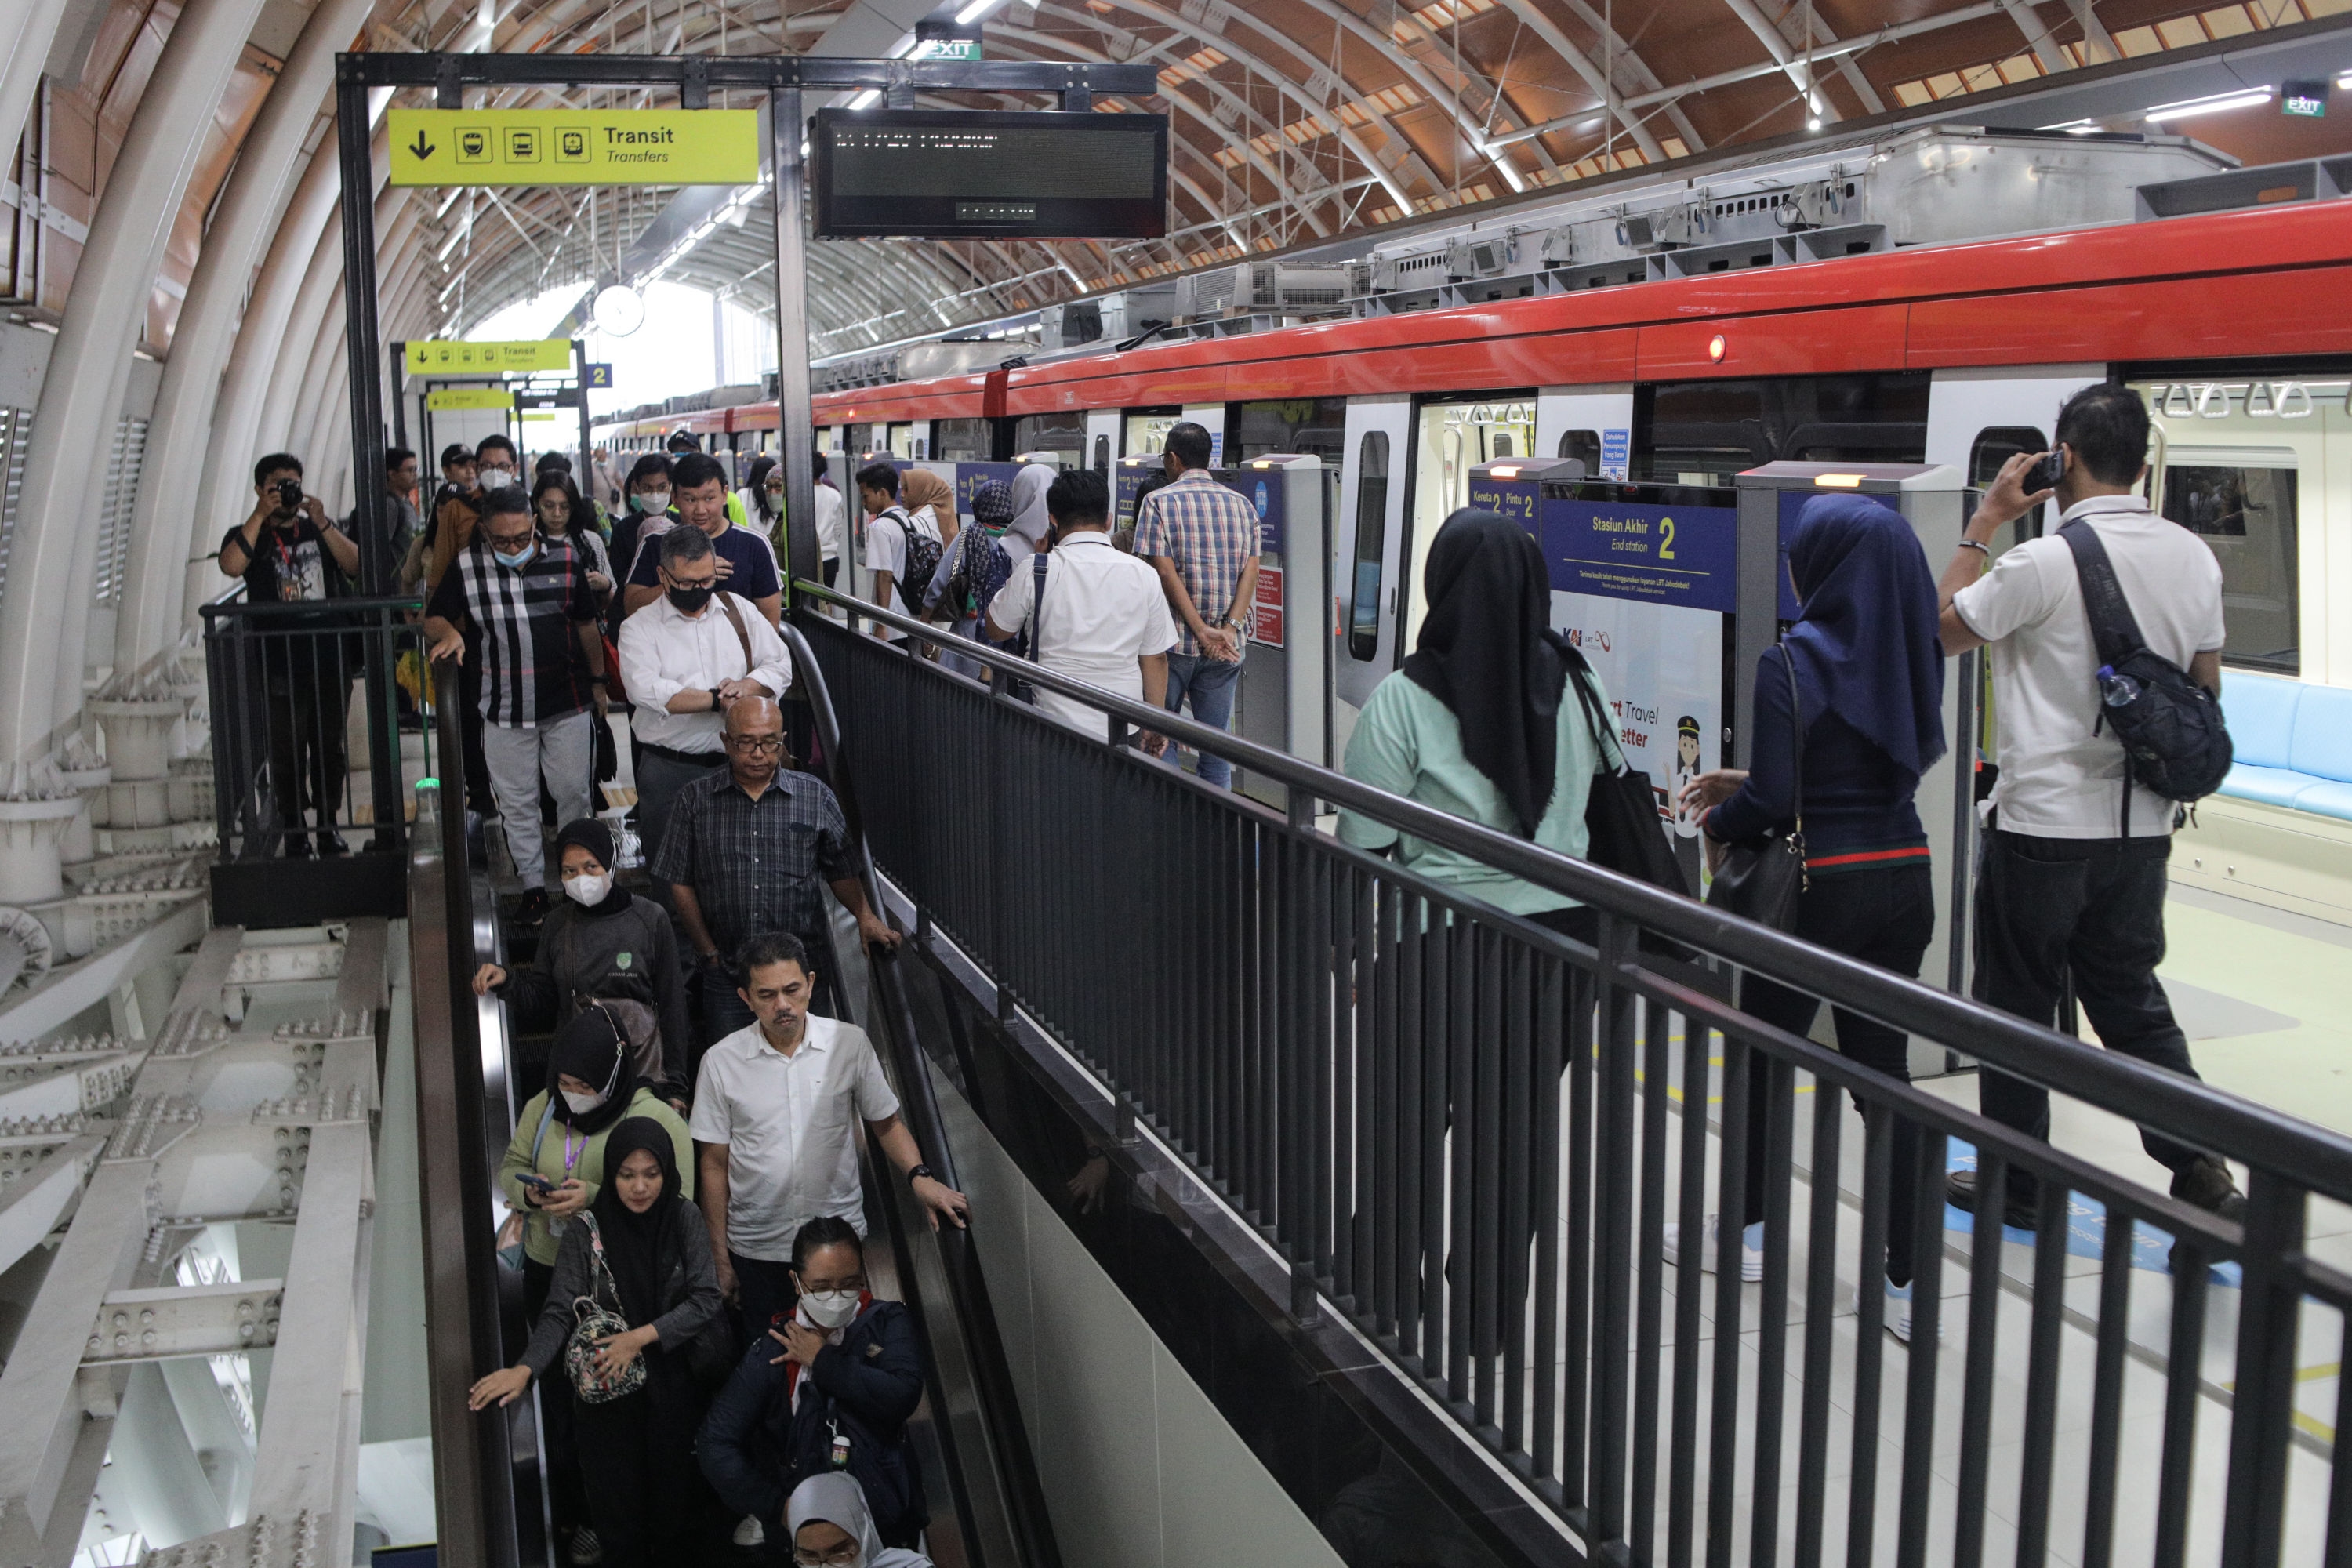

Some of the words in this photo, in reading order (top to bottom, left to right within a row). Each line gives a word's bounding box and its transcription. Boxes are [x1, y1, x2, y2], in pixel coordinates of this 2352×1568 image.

[927, 42, 973, 56] EXIT
[2288, 99, 2321, 111] EXIT
[603, 126, 675, 144] Transit
[606, 150, 669, 163] Transfers
[503, 346, 536, 355] Transit
[593, 367, 606, 384] 2
[1474, 490, 1492, 503] Kereta
[1493, 493, 1501, 514] 2
[1506, 492, 1522, 505] Pintu
[1525, 495, 1534, 517] 2
[1592, 516, 1623, 532] Stasiun
[1624, 518, 1649, 534] Akhir
[1611, 538, 1624, 550] End
[1625, 540, 1648, 552] station
[1659, 517, 1675, 560] 2
[1563, 627, 1582, 647] KAI
[1625, 701, 1659, 725] Travel
[1621, 728, 1648, 748] etter
